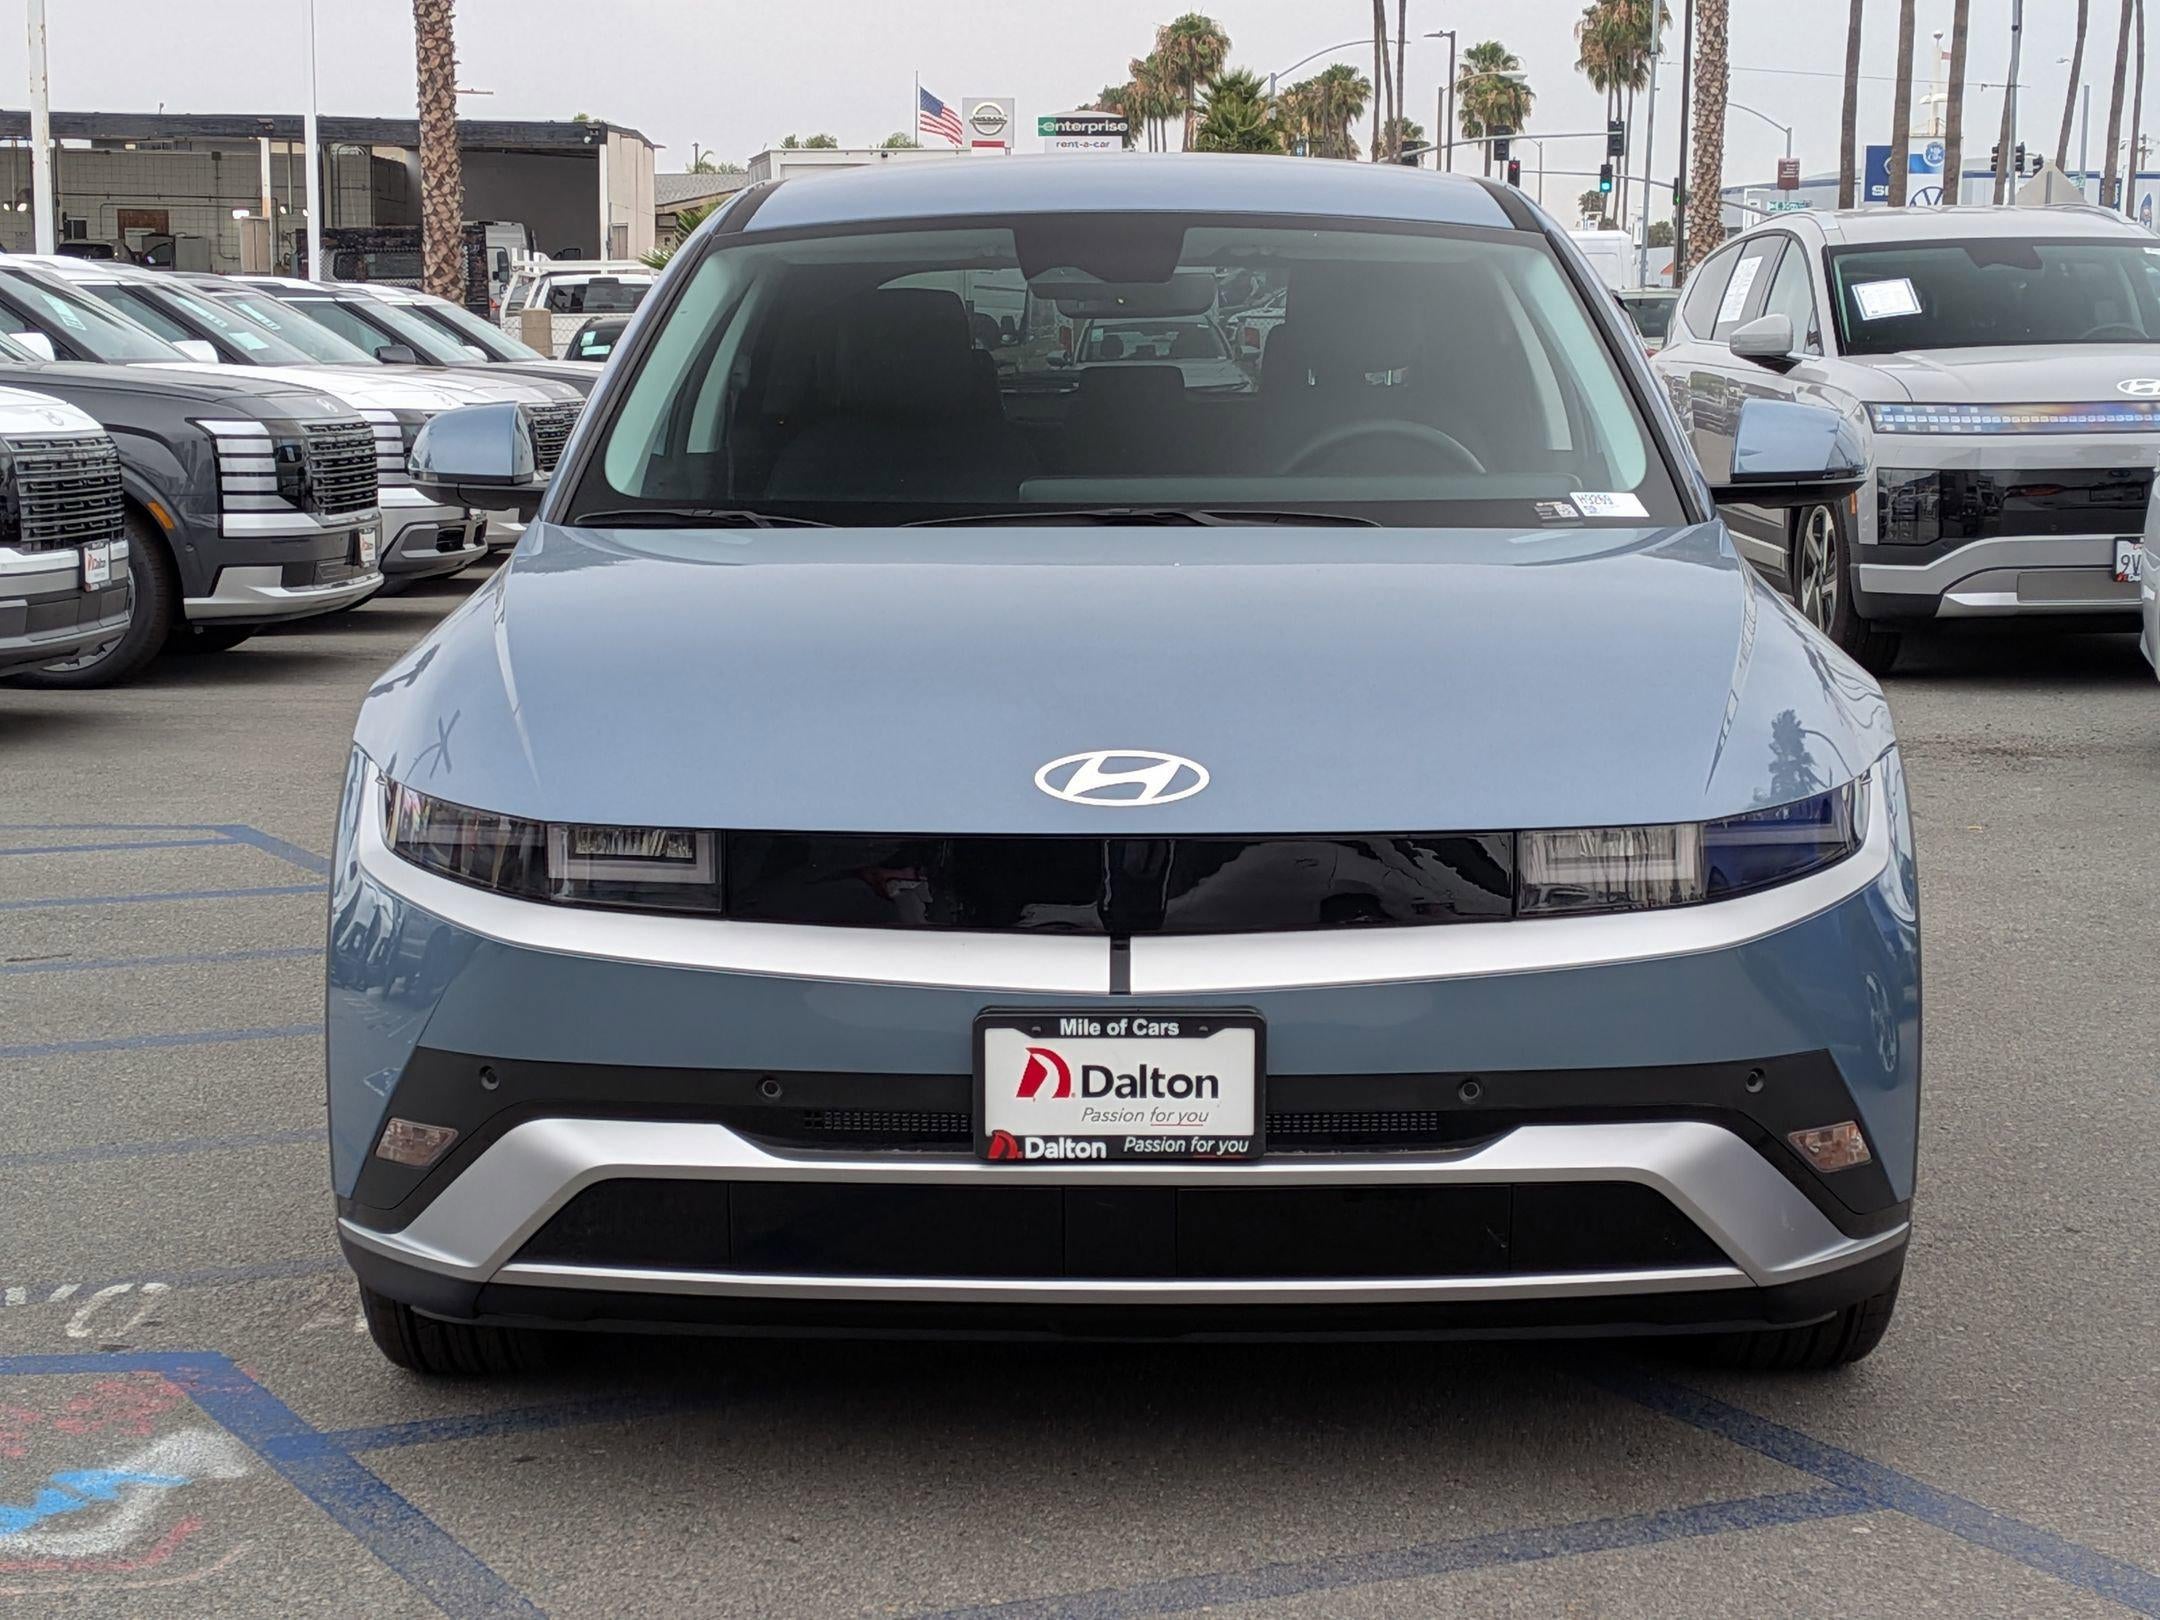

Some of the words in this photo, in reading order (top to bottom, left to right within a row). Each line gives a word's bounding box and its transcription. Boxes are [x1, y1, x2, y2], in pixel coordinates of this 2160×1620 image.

[1043, 120, 1128, 134] enterprise
[1060, 1019, 1100, 1036] Mile
[1107, 1019, 1127, 1036] of
[1132, 1020, 1179, 1036] Cars
[1082, 1064, 1218, 1099] Dalton
[1082, 1108, 1144, 1122] Passion
[1150, 1107, 1175, 1124] for
[1178, 1111, 1209, 1124] you
[1025, 1137, 1106, 1159] Dalton
[1124, 1137, 1186, 1153] Passion
[1191, 1137, 1215, 1154] for
[1217, 1140, 1249, 1155] you
